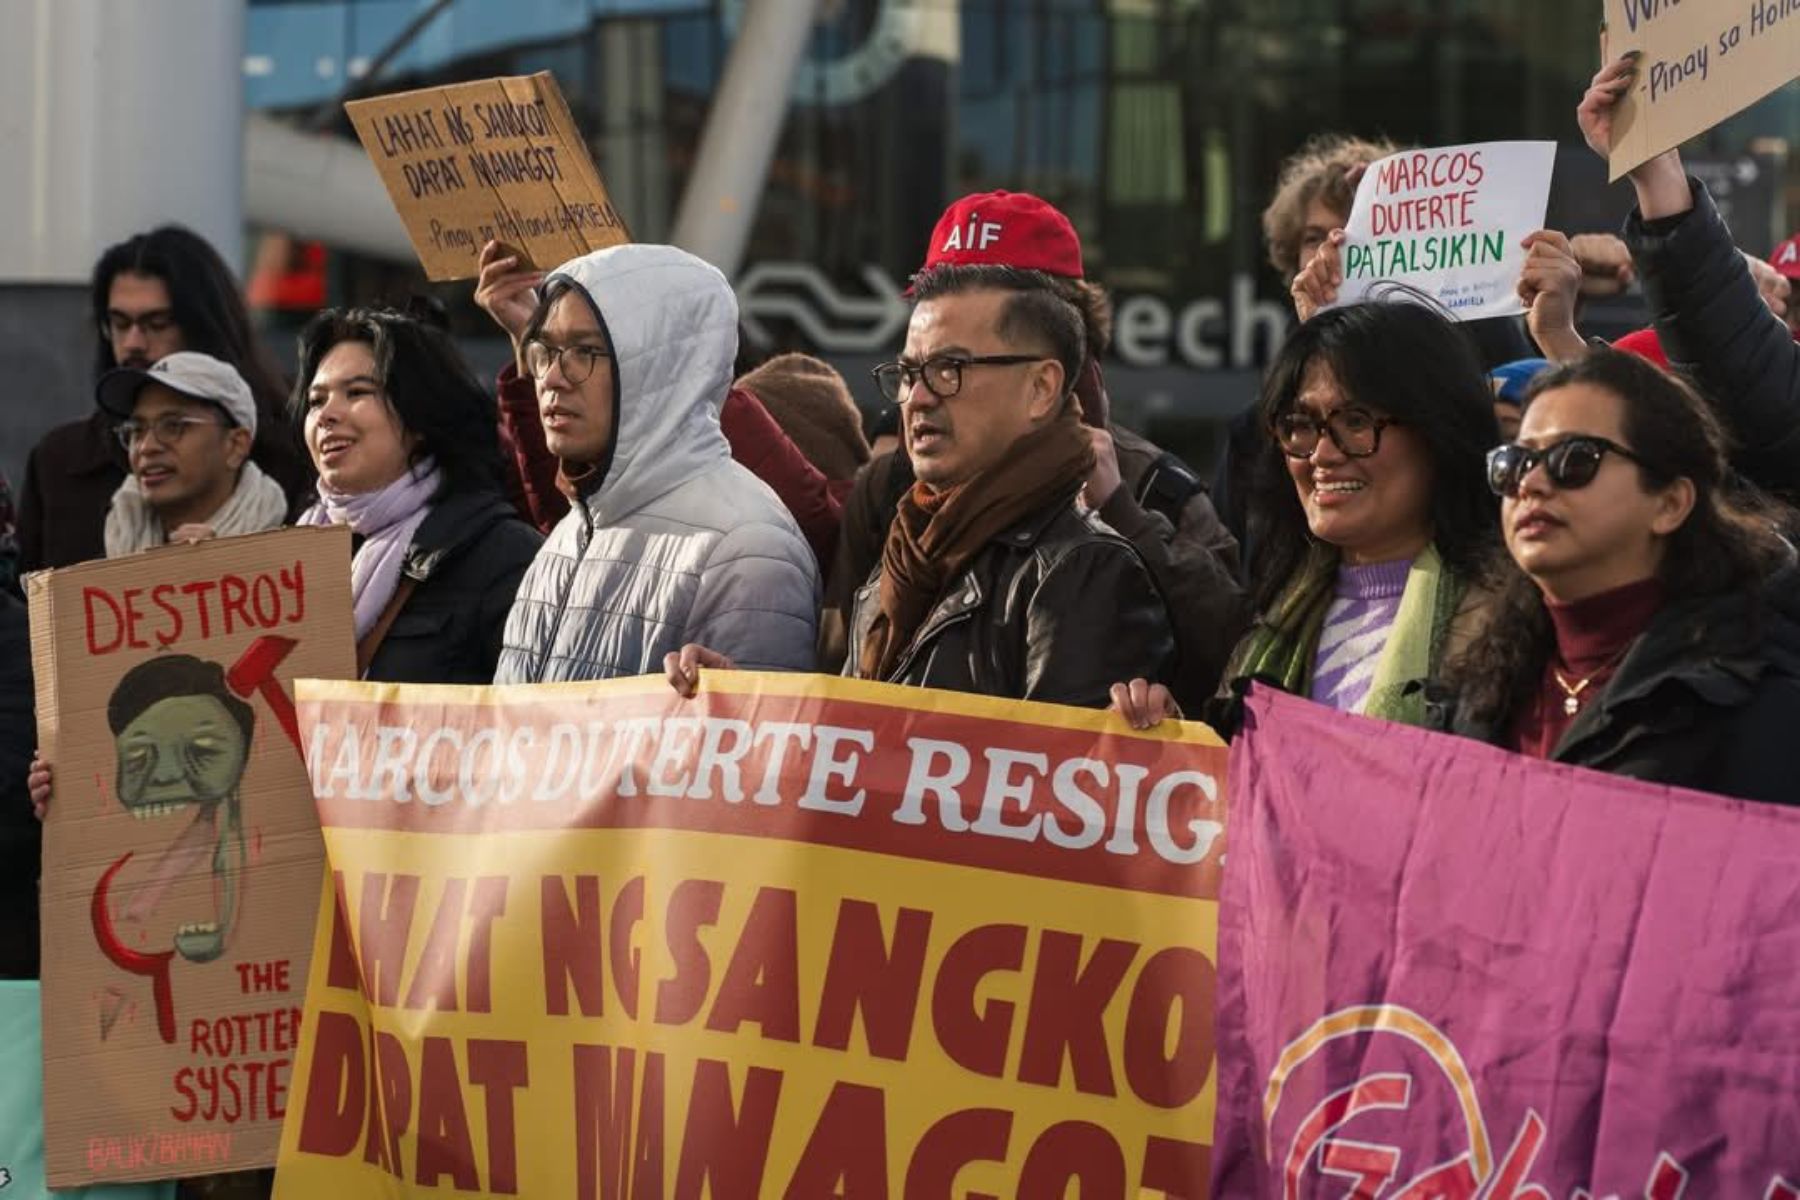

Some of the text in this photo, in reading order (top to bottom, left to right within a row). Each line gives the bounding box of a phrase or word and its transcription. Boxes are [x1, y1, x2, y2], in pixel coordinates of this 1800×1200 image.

[1720, 25, 1740, 56] sa
[371, 109, 444, 158] LAHAT
[443, 105, 474, 147] NG
[403, 146, 563, 198] DAPAT MANAGOT
[1376, 151, 1484, 196] MARCOS
[1372, 190, 1478, 237] DUTERTE
[1346, 229, 1504, 279] PATALSIKIN
[83, 560, 305, 655] DESTROY
[532, 715, 875, 817] DUTERTE
[892, 737, 1227, 866] RESIG
[236, 960, 290, 993] THE
[541, 874, 645, 1022] NG
[654, 878, 1218, 1109] SANGKO
[170, 1059, 290, 1123] SYSTE
